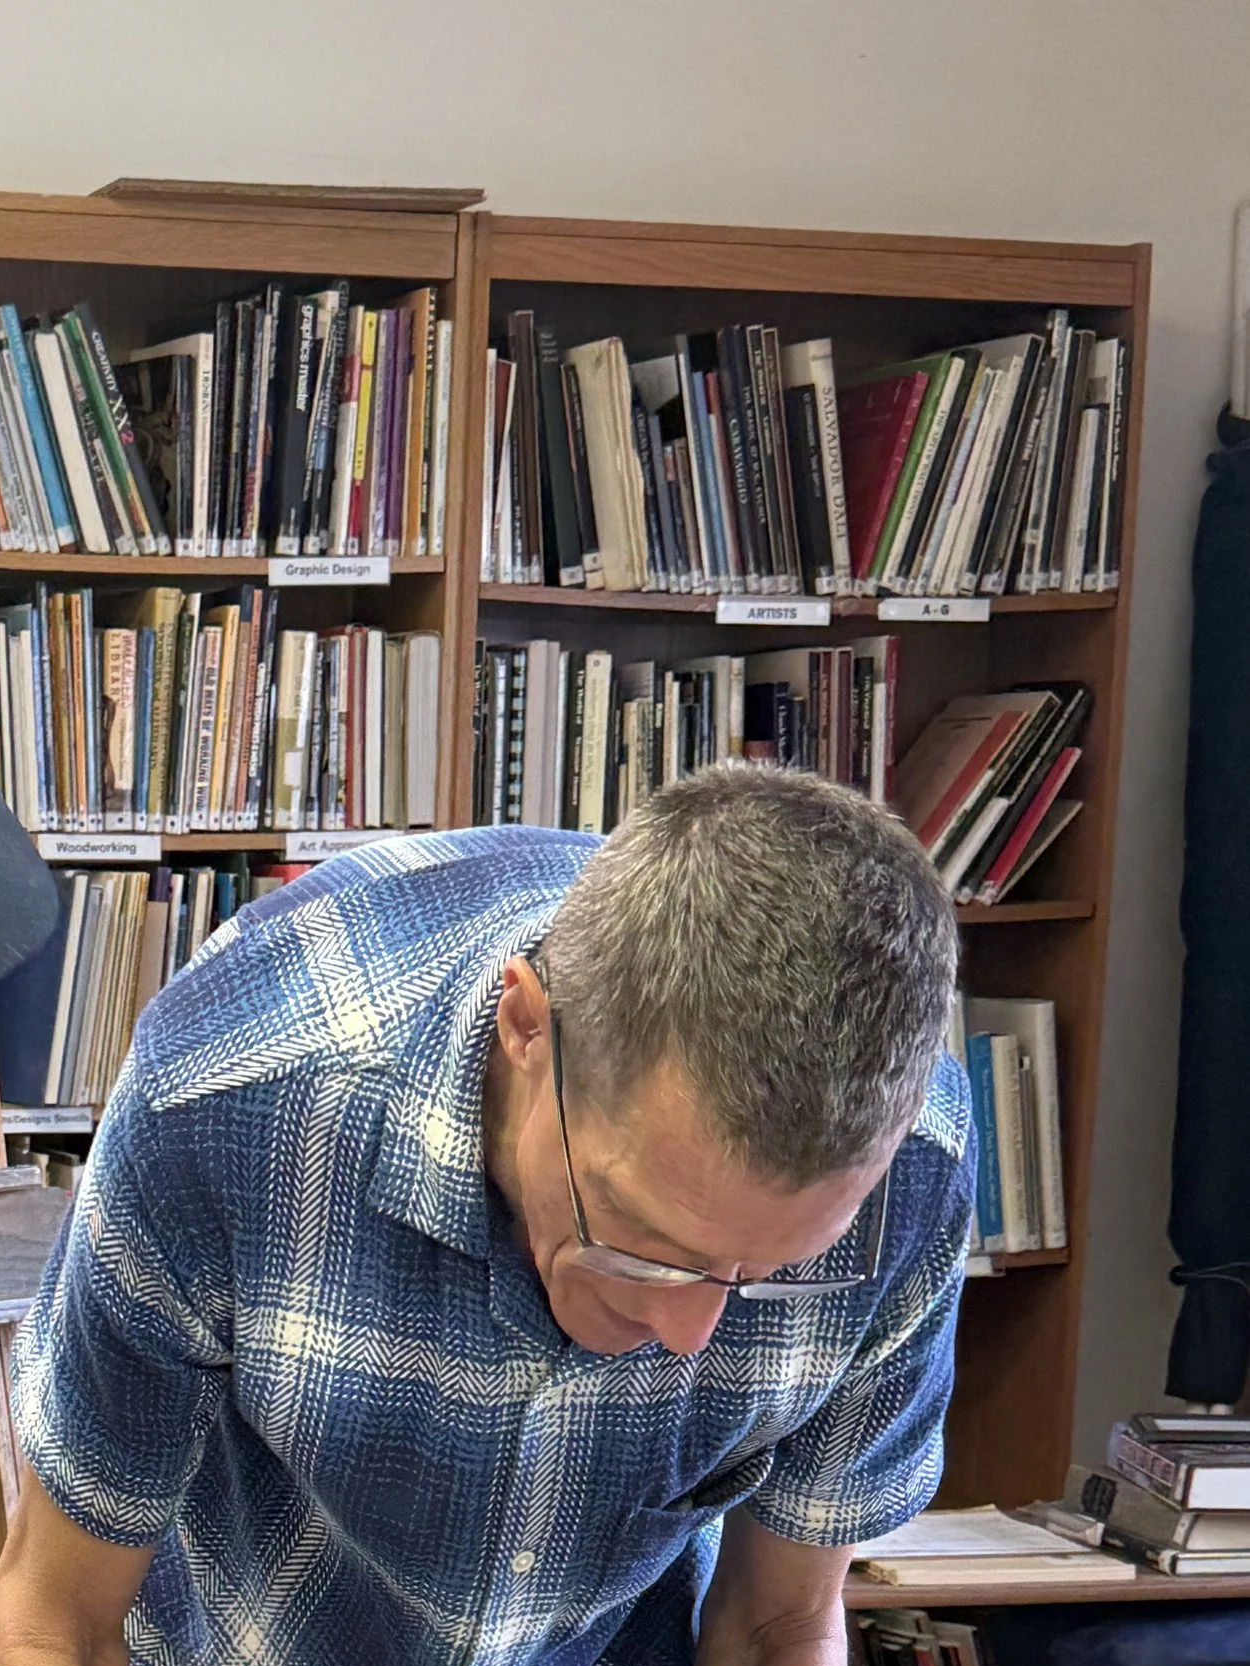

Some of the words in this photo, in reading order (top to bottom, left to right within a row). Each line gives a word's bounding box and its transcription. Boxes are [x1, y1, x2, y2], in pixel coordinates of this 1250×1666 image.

[300, 304, 314, 361] graphics
[91, 331, 118, 391] CREATIVITY
[295, 364, 309, 411] master
[822, 386, 843, 485] SALVADOR
[728, 418, 748, 505] CARAVAGGIO
[285, 564, 329, 577] Graphic
[332, 563, 370, 576] Design
[748, 607, 798, 619] ARTISTS
[922, 604, 931, 615] A
[941, 604, 950, 615] G
[204, 666, 217, 686] OLD
[200, 719, 212, 731] OF
[196, 735, 211, 782] WORKING
[56, 842, 137, 855] Woodworking
[299, 841, 317, 852] Art
